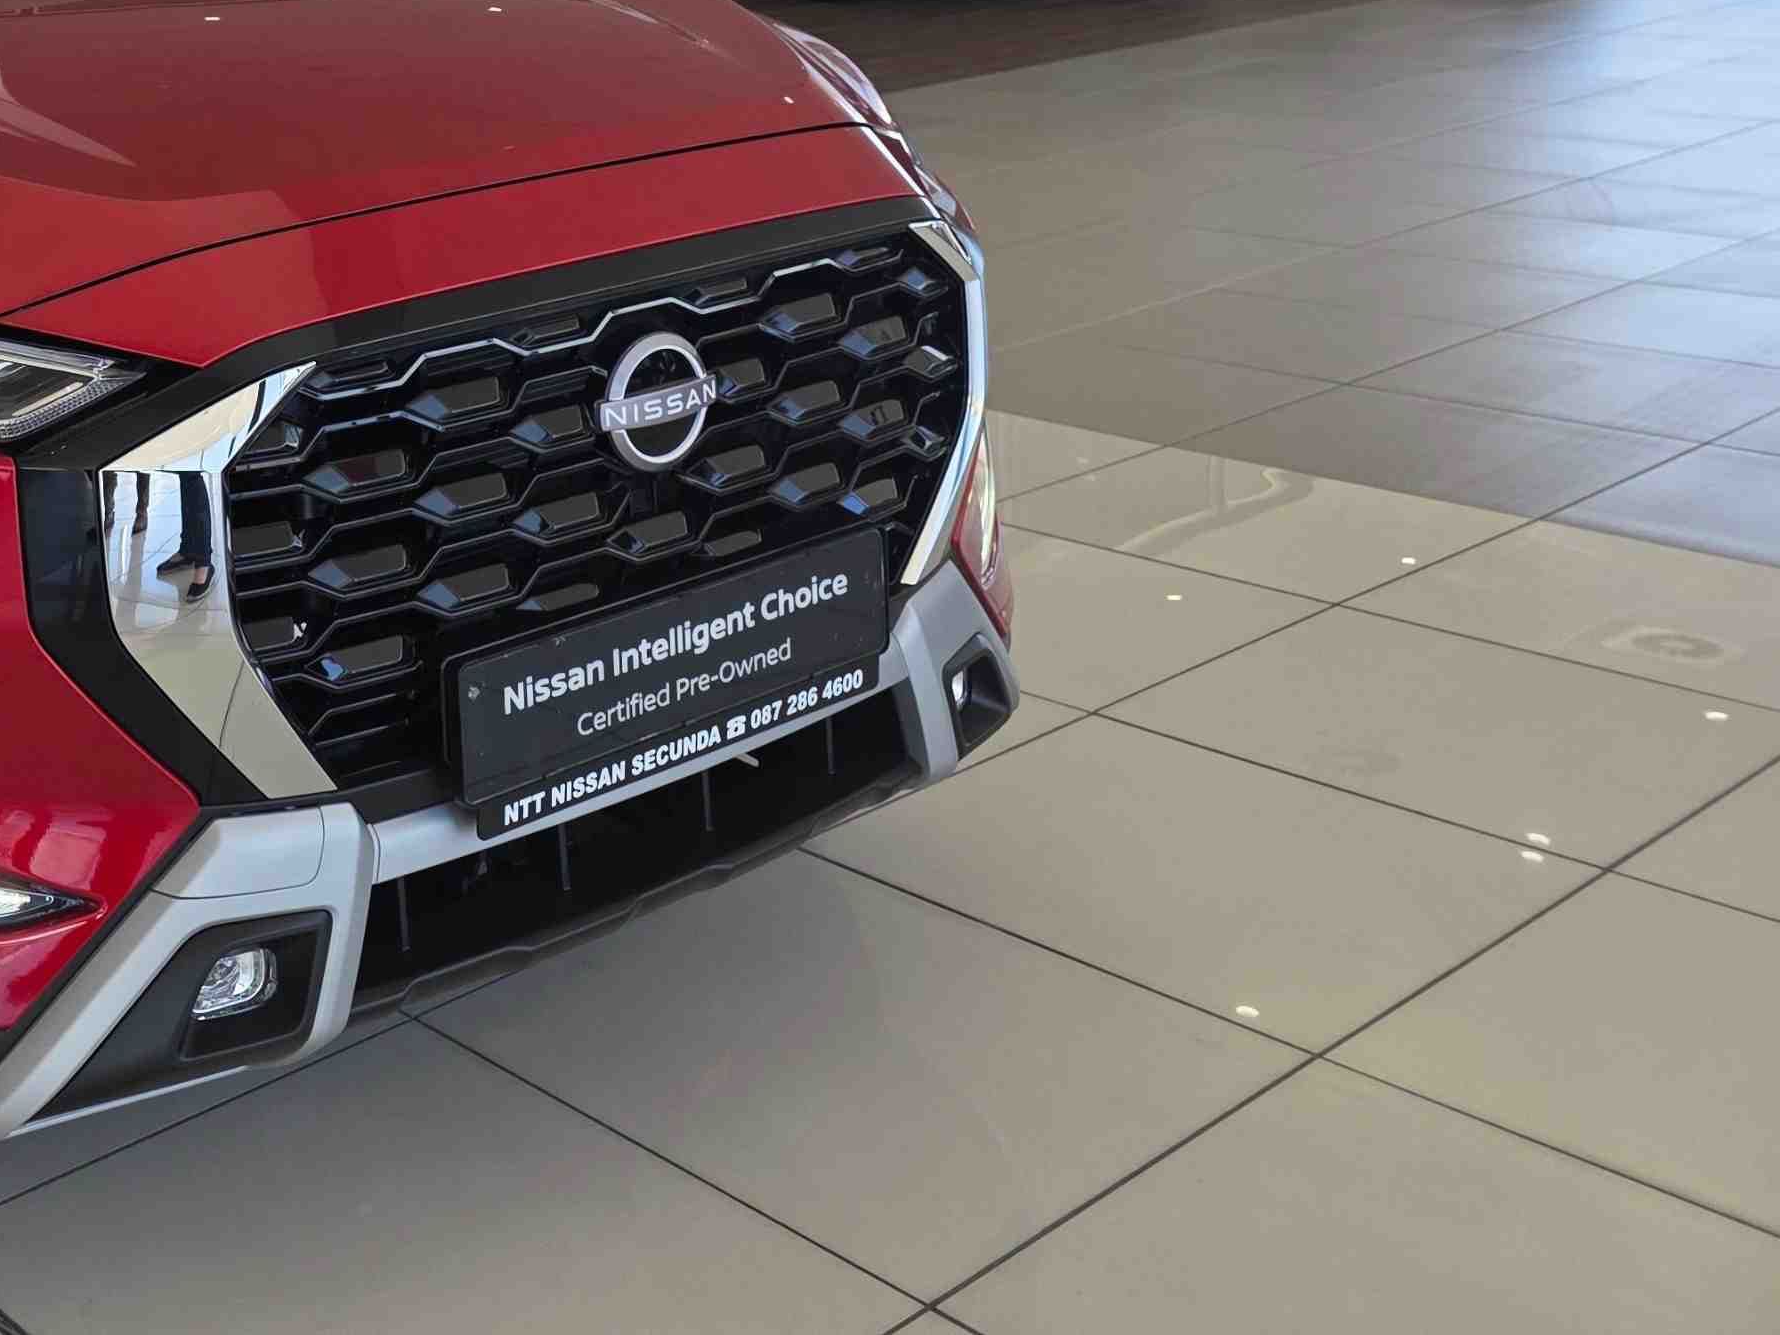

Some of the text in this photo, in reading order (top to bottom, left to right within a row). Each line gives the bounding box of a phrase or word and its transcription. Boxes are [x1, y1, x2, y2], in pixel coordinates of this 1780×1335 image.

[604, 379, 716, 427] NISSAN
[504, 573, 848, 715] Nissan Intelligent Choice
[577, 637, 792, 736] Certified Pre-Owned
[504, 668, 864, 826] NTT NISSAN SECUNDA 087 286 4600
